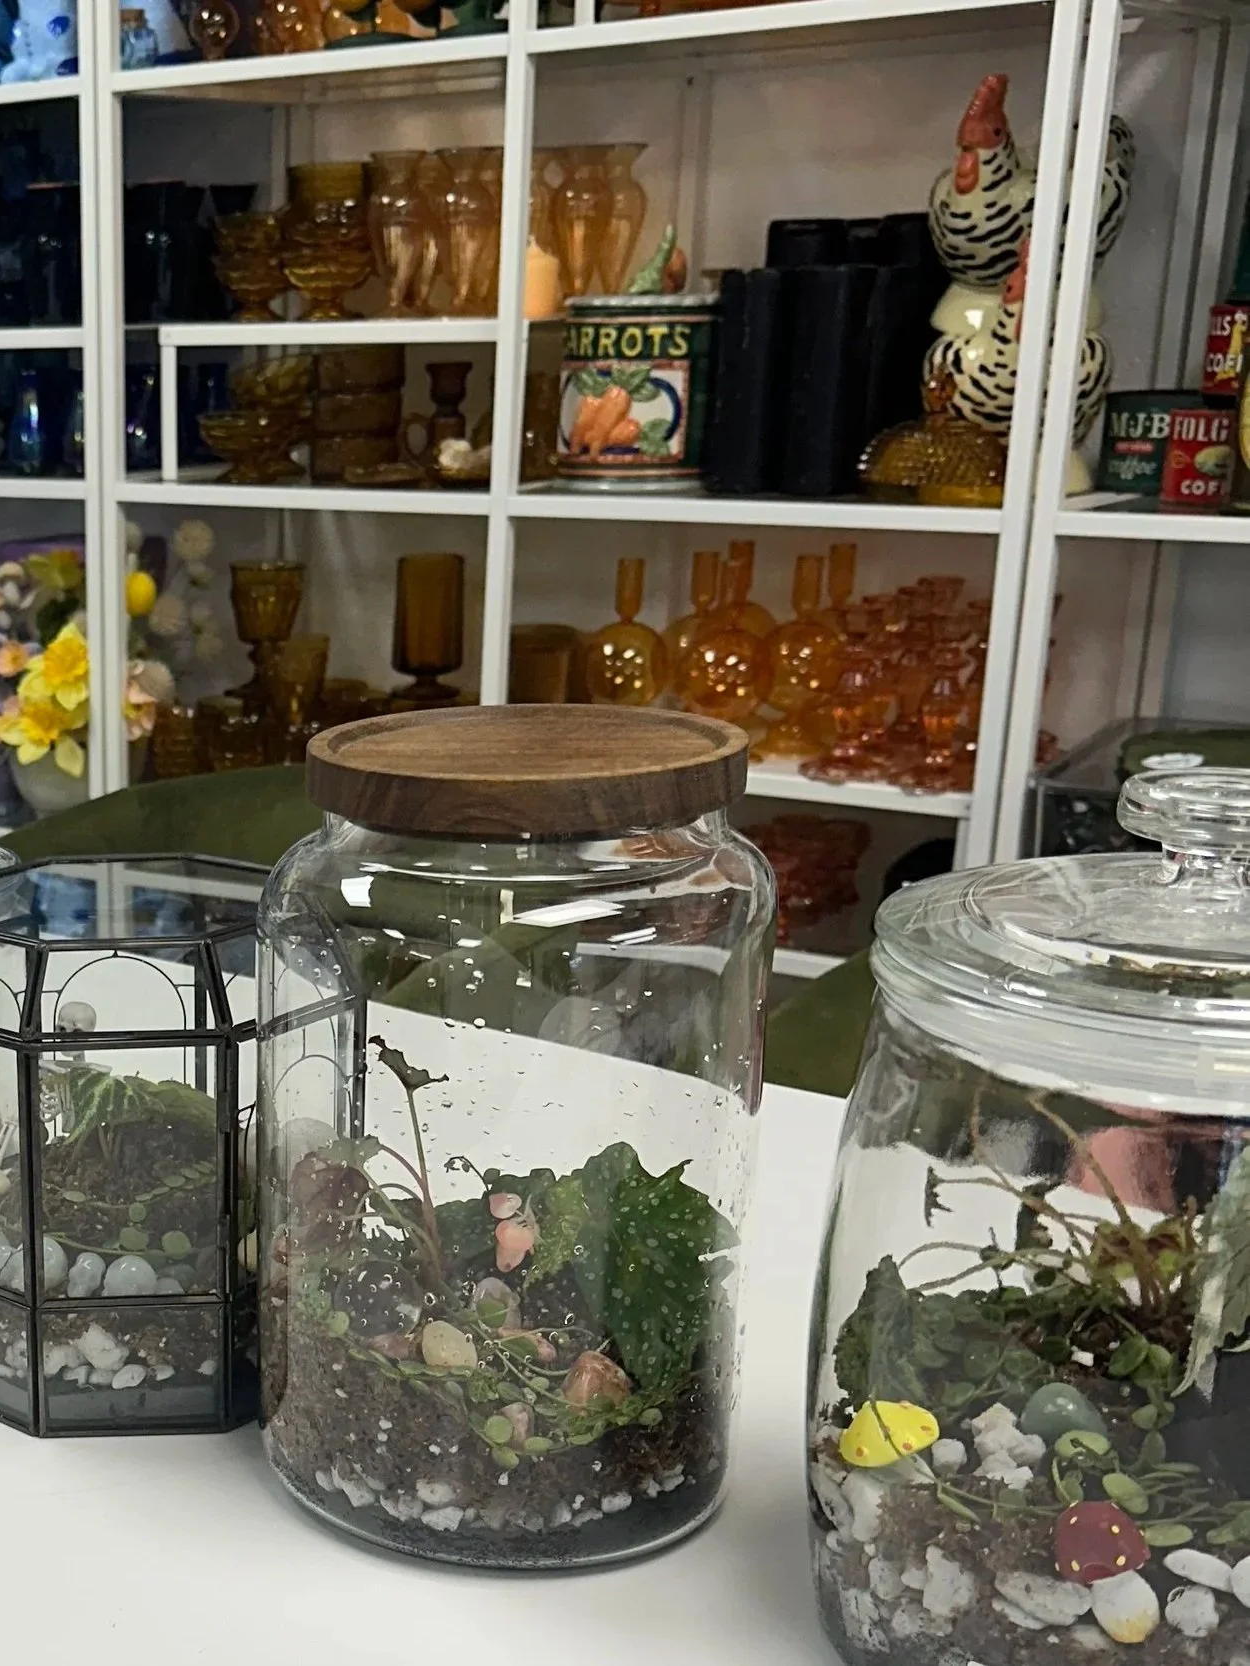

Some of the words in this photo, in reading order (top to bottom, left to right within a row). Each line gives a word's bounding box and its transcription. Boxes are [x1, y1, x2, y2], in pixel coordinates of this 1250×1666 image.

[1210, 314, 1232, 337] LLS
[565, 324, 692, 358] ARROTS
[1172, 415, 1230, 442] FOLG
[1180, 479, 1226, 496] COF
